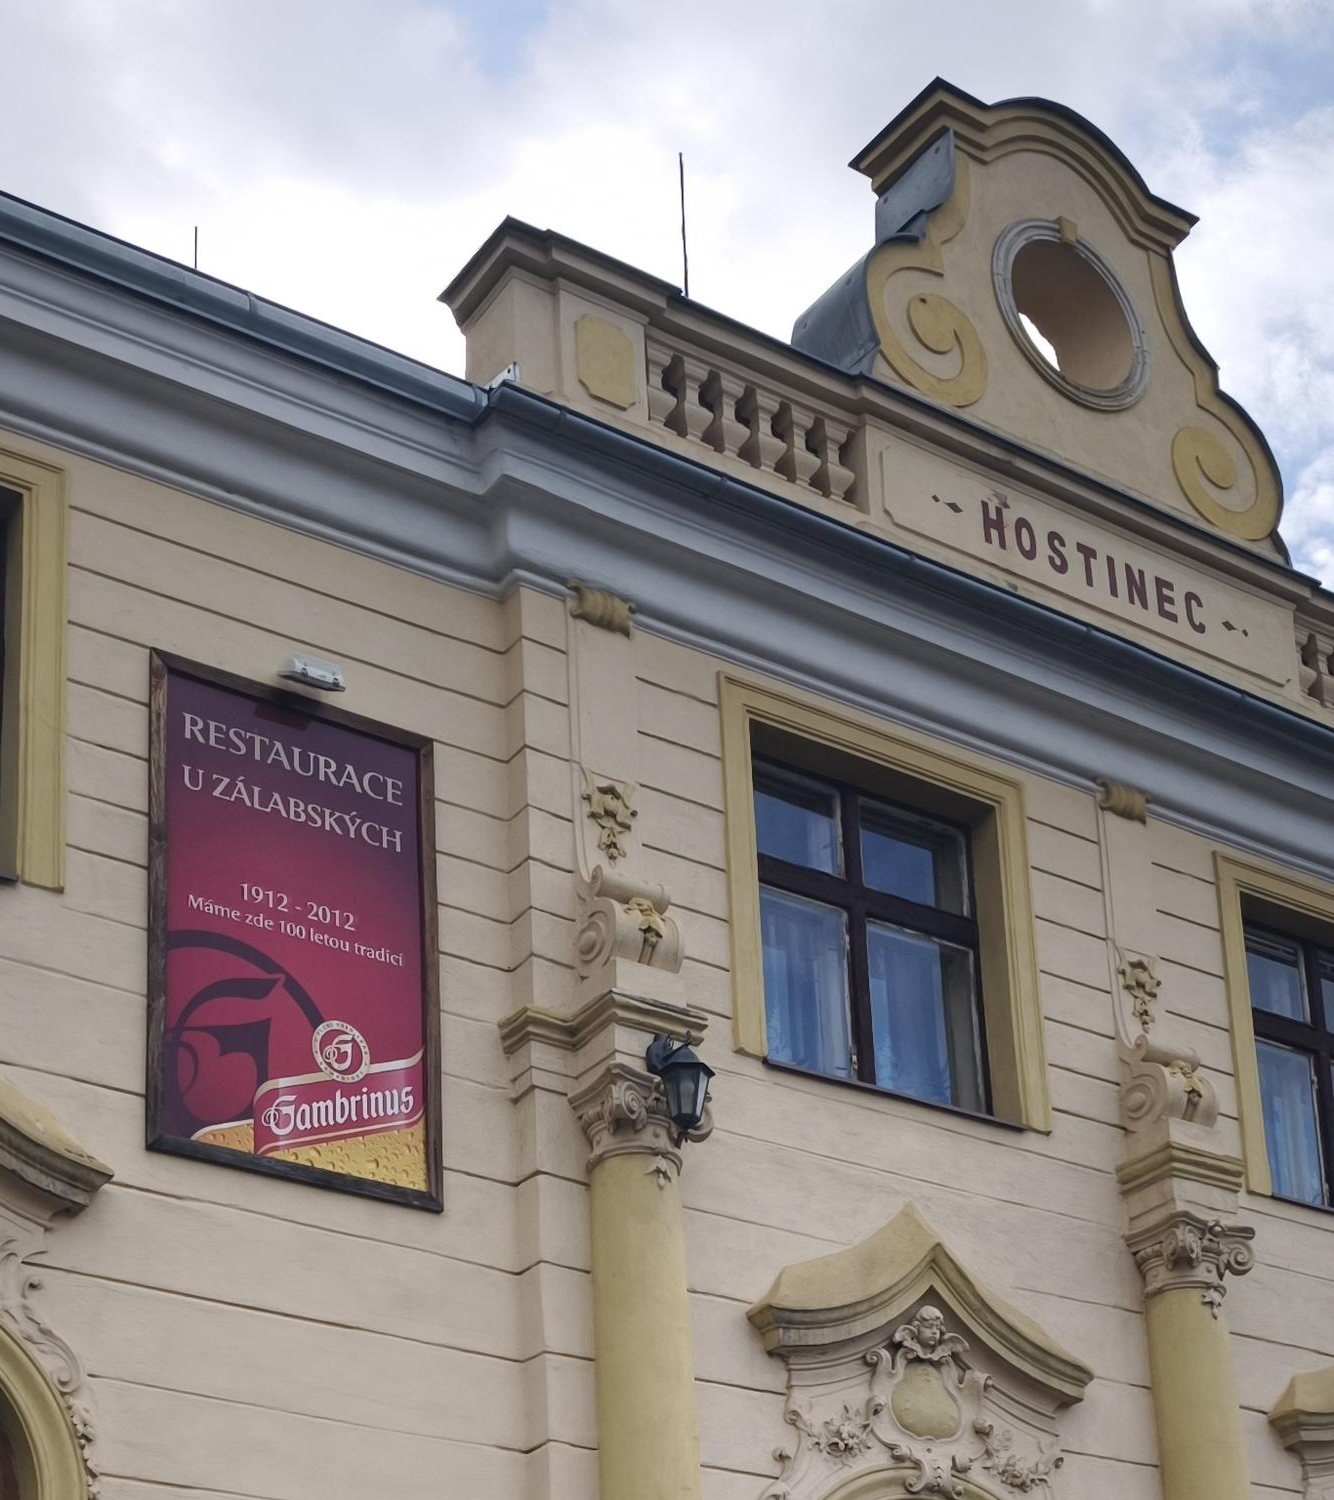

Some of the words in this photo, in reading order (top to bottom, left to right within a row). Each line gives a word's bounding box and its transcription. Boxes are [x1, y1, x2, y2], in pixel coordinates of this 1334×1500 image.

[981, 500, 1206, 634] HOSTINEC
[182, 711, 404, 807] RESTAURACE
[182, 764, 204, 792] U
[212, 772, 403, 853] ZÁLABSKÝCH
[188, 894, 241, 923] Máme
[244, 909, 275, 932] zde
[279, 918, 307, 941] 100
[309, 923, 351, 952] letou
[353, 934, 405, 967] tradicí
[240, 882, 289, 914] 1912
[307, 900, 356, 932] 2012
[262, 1084, 414, 1137] Gambrinus
